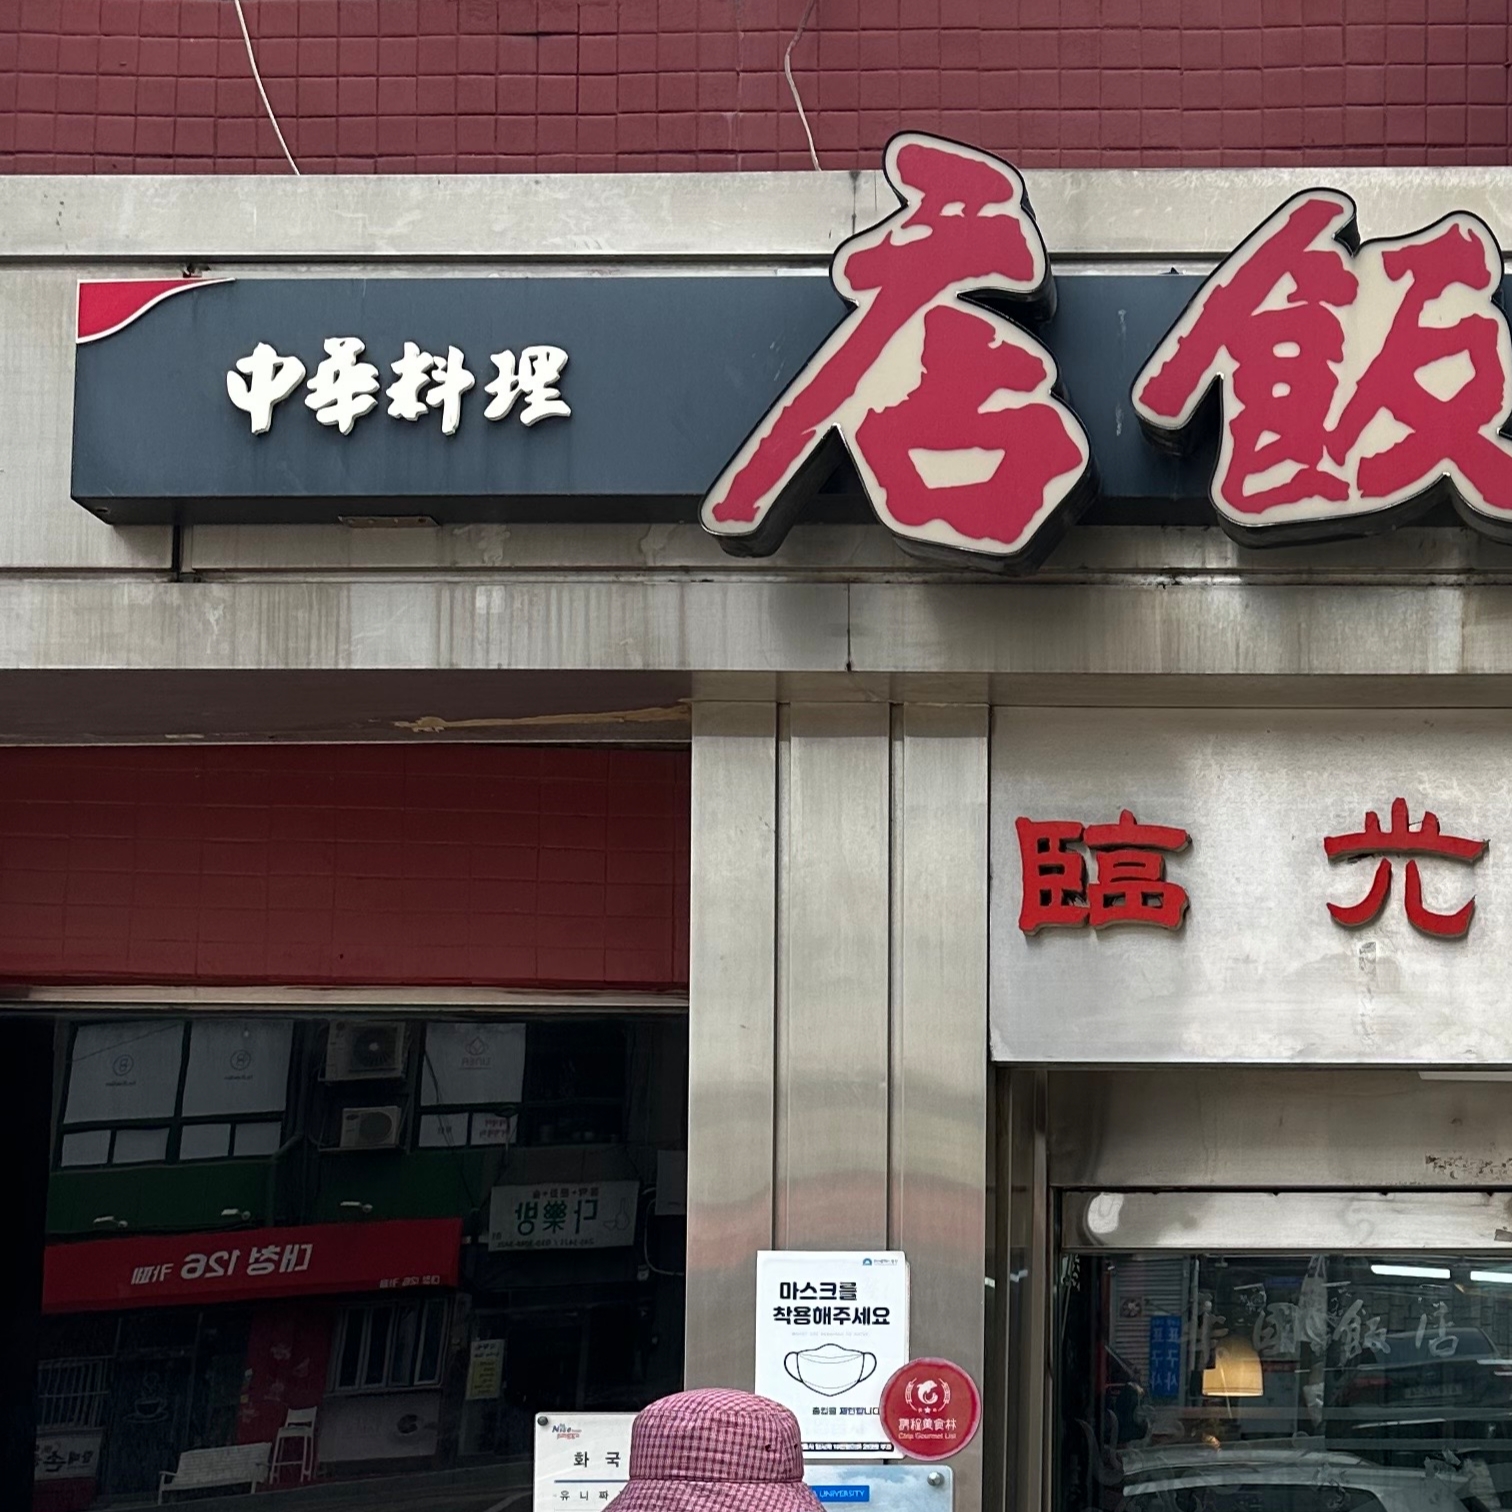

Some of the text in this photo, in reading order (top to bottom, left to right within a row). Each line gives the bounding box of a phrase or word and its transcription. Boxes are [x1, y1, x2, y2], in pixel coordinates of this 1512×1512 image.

[226, 337, 572, 436] 中華料理
[779, 1281, 858, 1301] 마스크를
[773, 1306, 891, 1326] 착용해주세요
[819, 1489, 866, 1498] UNIVERSITY
